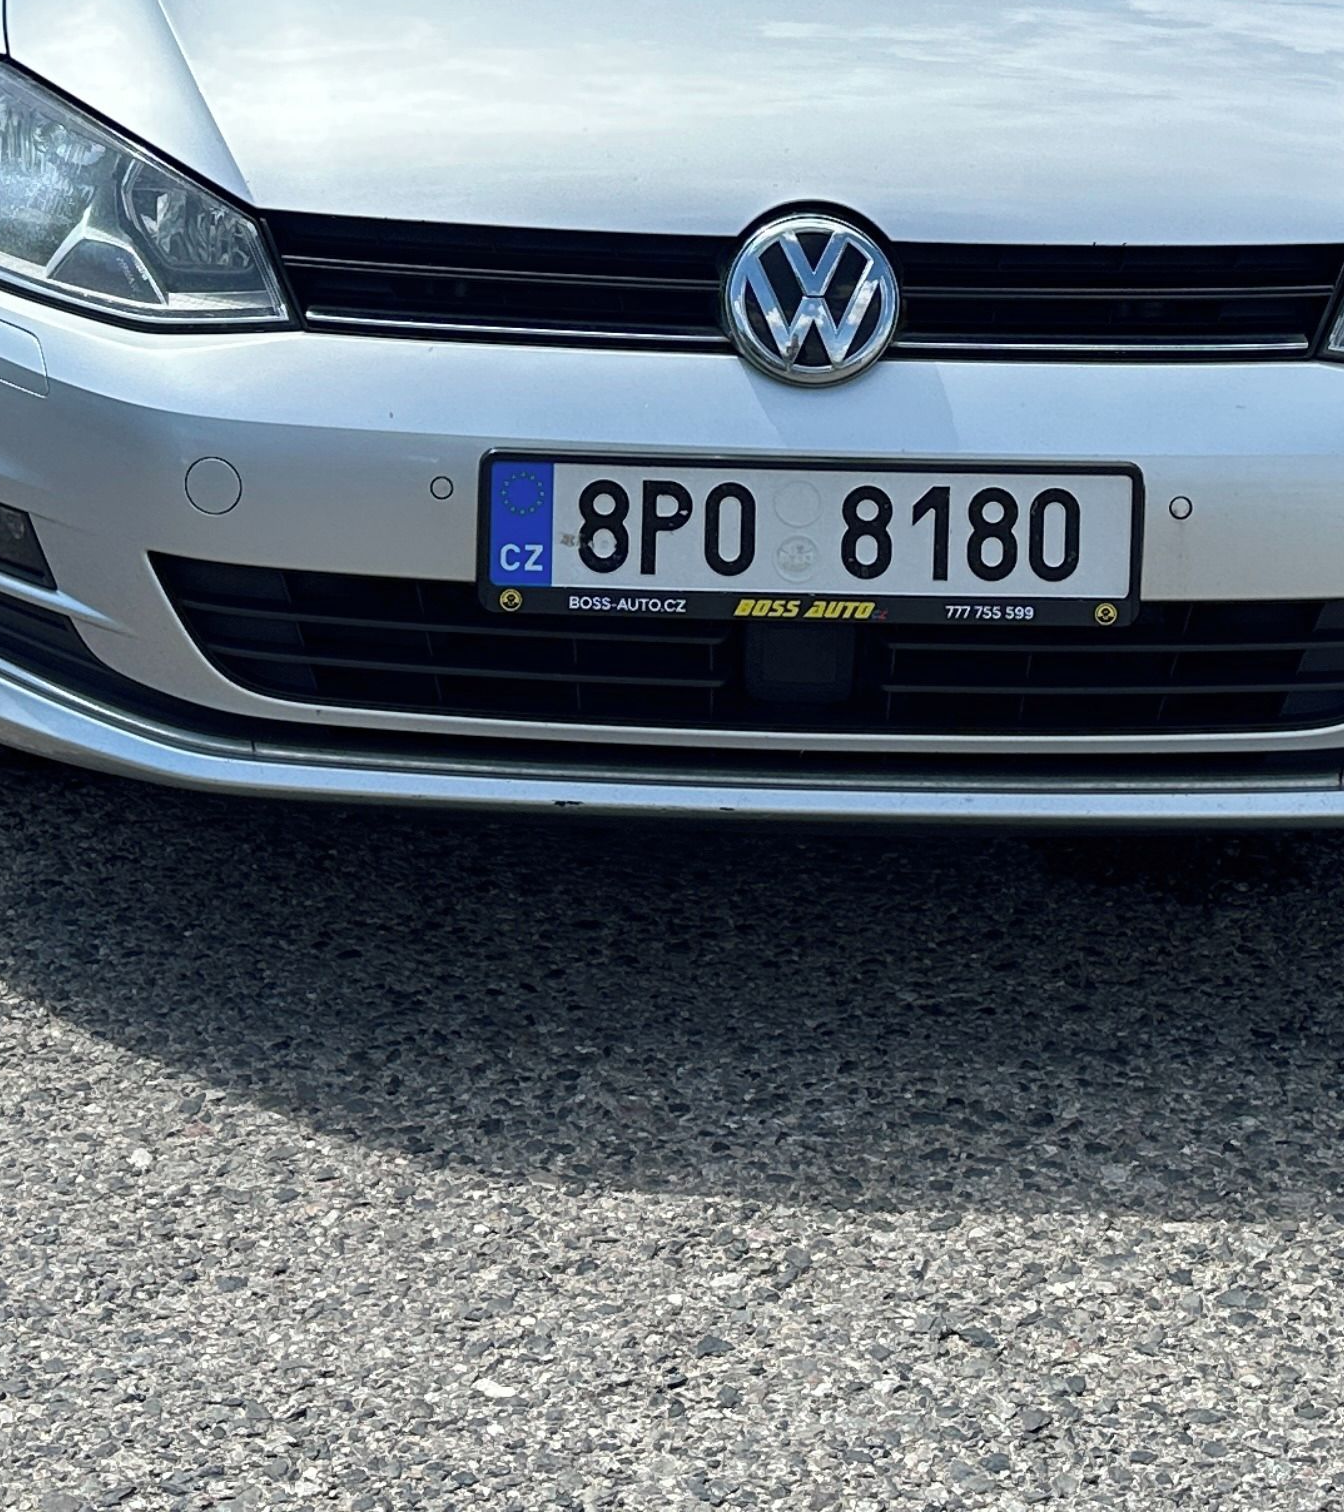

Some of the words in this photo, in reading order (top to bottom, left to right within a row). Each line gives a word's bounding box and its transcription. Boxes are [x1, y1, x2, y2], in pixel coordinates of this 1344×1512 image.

[499, 543, 544, 574] CZ
[841, 485, 1081, 582] 8180
[568, 595, 687, 614] BOSS-AUTO.CZ
[733, 599, 800, 618] BOSS
[803, 600, 876, 619] AUTO
[945, 605, 971, 619] 777
[974, 605, 1002, 619] 755
[1005, 606, 1034, 620] 599
